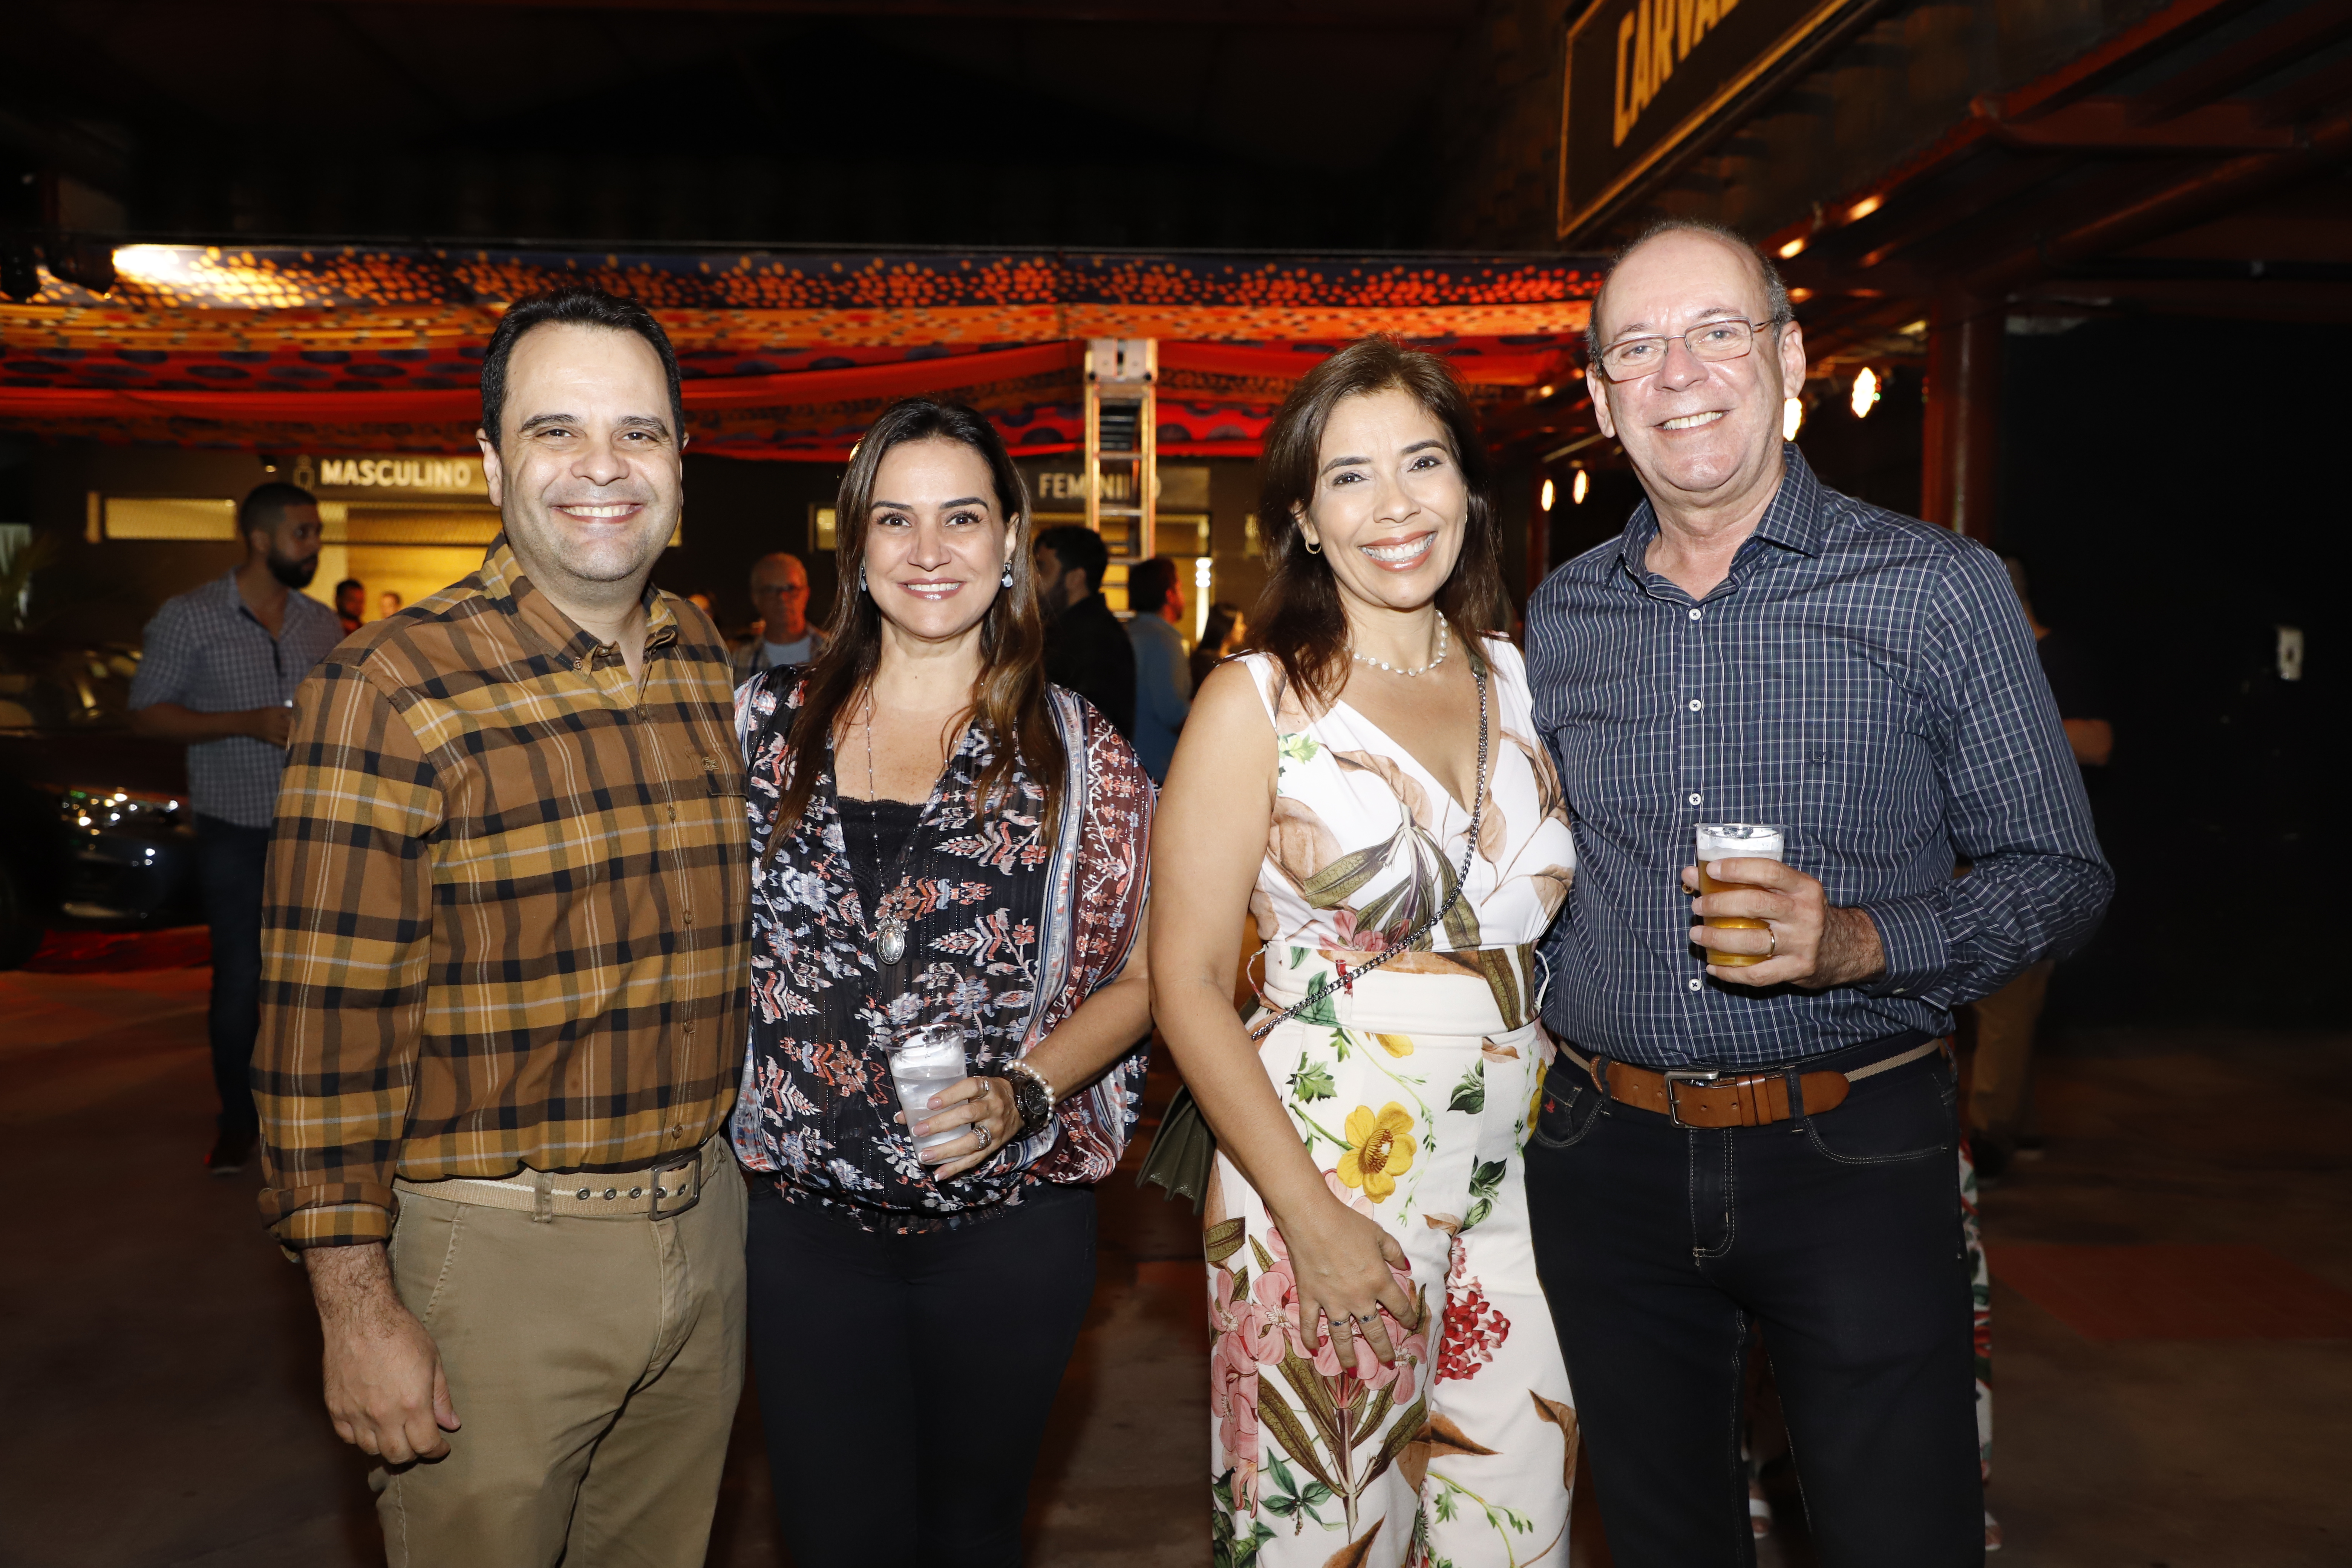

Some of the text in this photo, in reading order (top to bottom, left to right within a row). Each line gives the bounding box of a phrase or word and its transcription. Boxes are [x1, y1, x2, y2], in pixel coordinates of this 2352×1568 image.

[1614, 0, 1740, 148] CARV
[320, 459, 471, 487] MASCULINO
[1039, 472, 1162, 499] FEMNI
